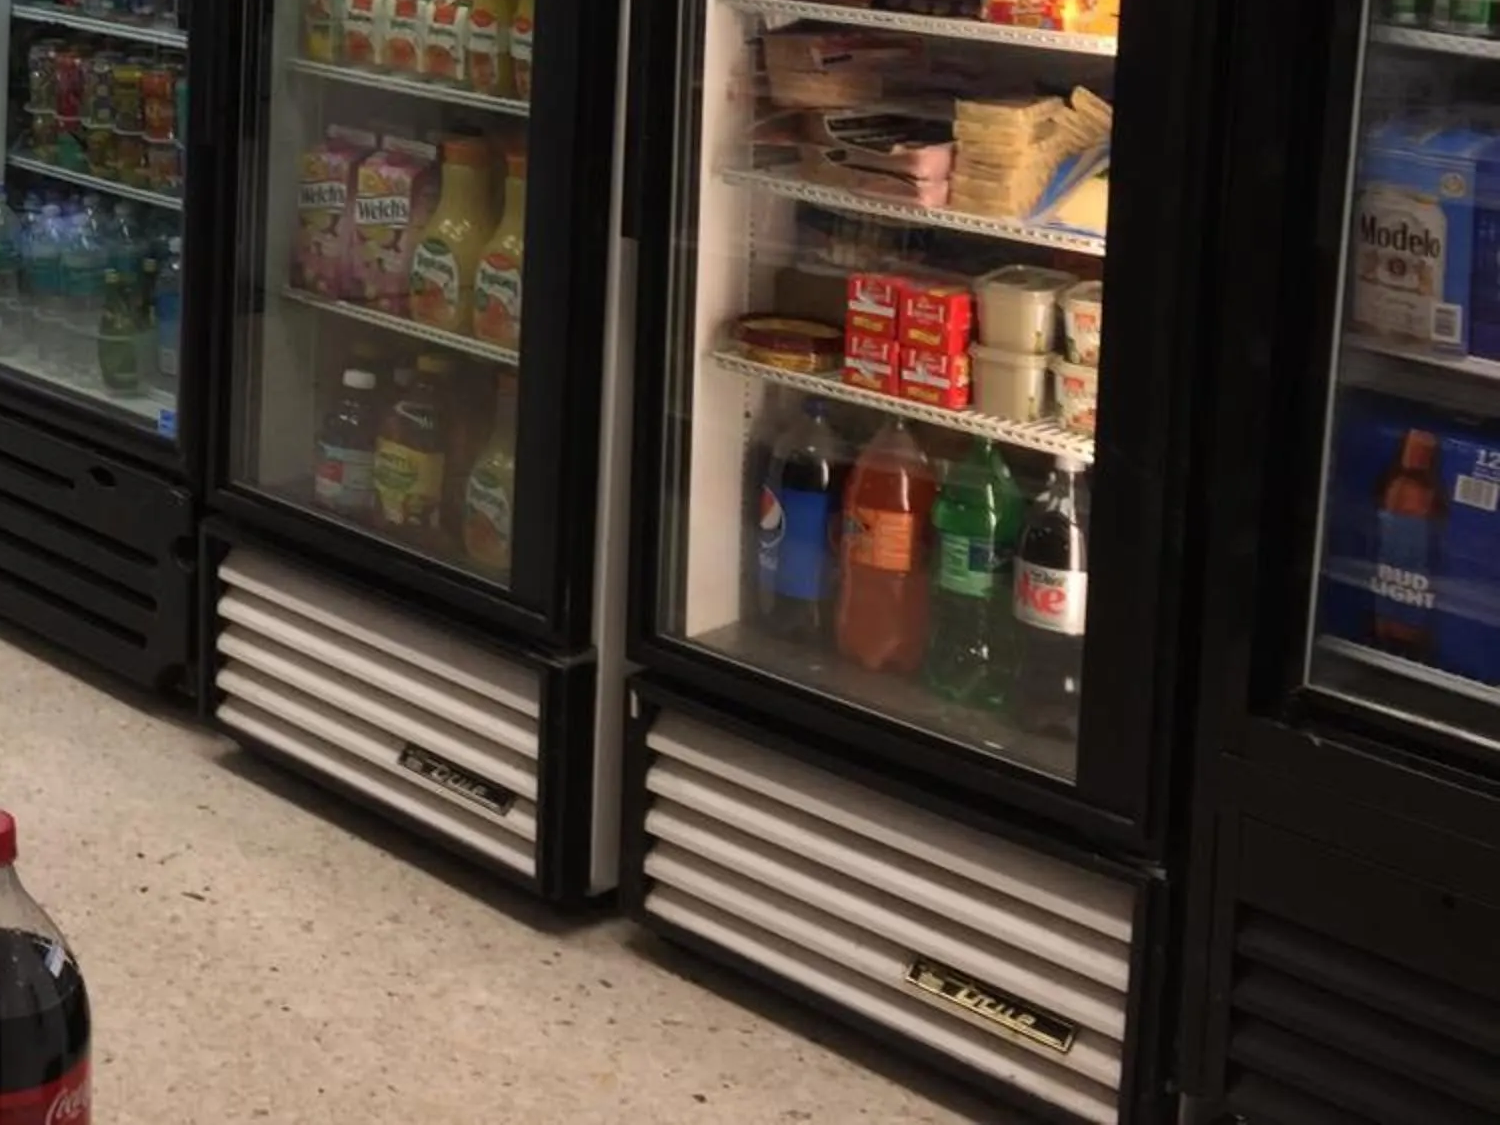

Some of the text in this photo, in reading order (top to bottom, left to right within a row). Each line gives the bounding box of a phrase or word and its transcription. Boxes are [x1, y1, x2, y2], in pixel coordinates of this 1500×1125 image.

[357, 199, 409, 220] Welch's
[1360, 212, 1441, 258] Modelo
[1018, 570, 1067, 615] ke
